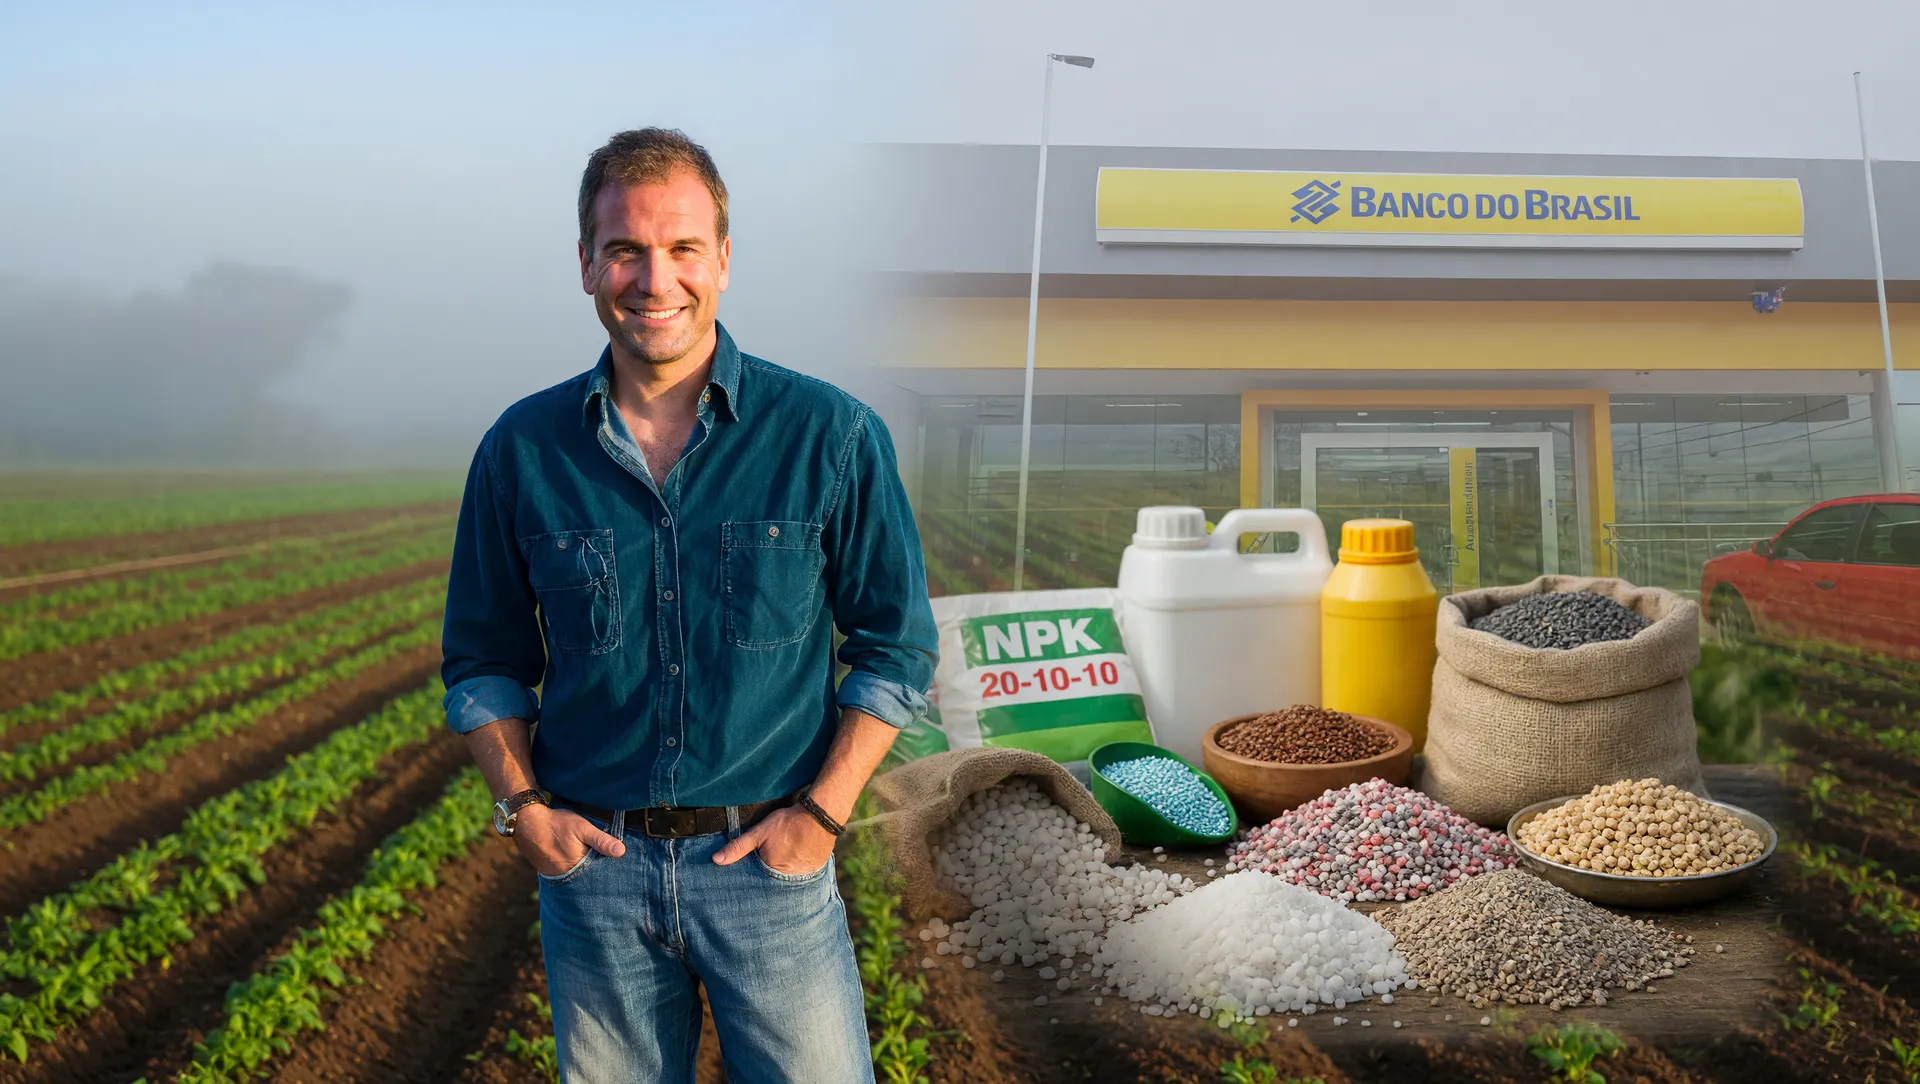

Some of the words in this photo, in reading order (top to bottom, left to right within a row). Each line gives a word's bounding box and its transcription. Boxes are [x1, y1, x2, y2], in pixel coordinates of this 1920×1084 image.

[1351, 186, 1469, 219] BANCO
[1475, 193, 1519, 220] DO
[1524, 189, 1641, 221] BRASIL
[982, 617, 1102, 661] NPK
[979, 661, 1118, 700] 20-10-10
